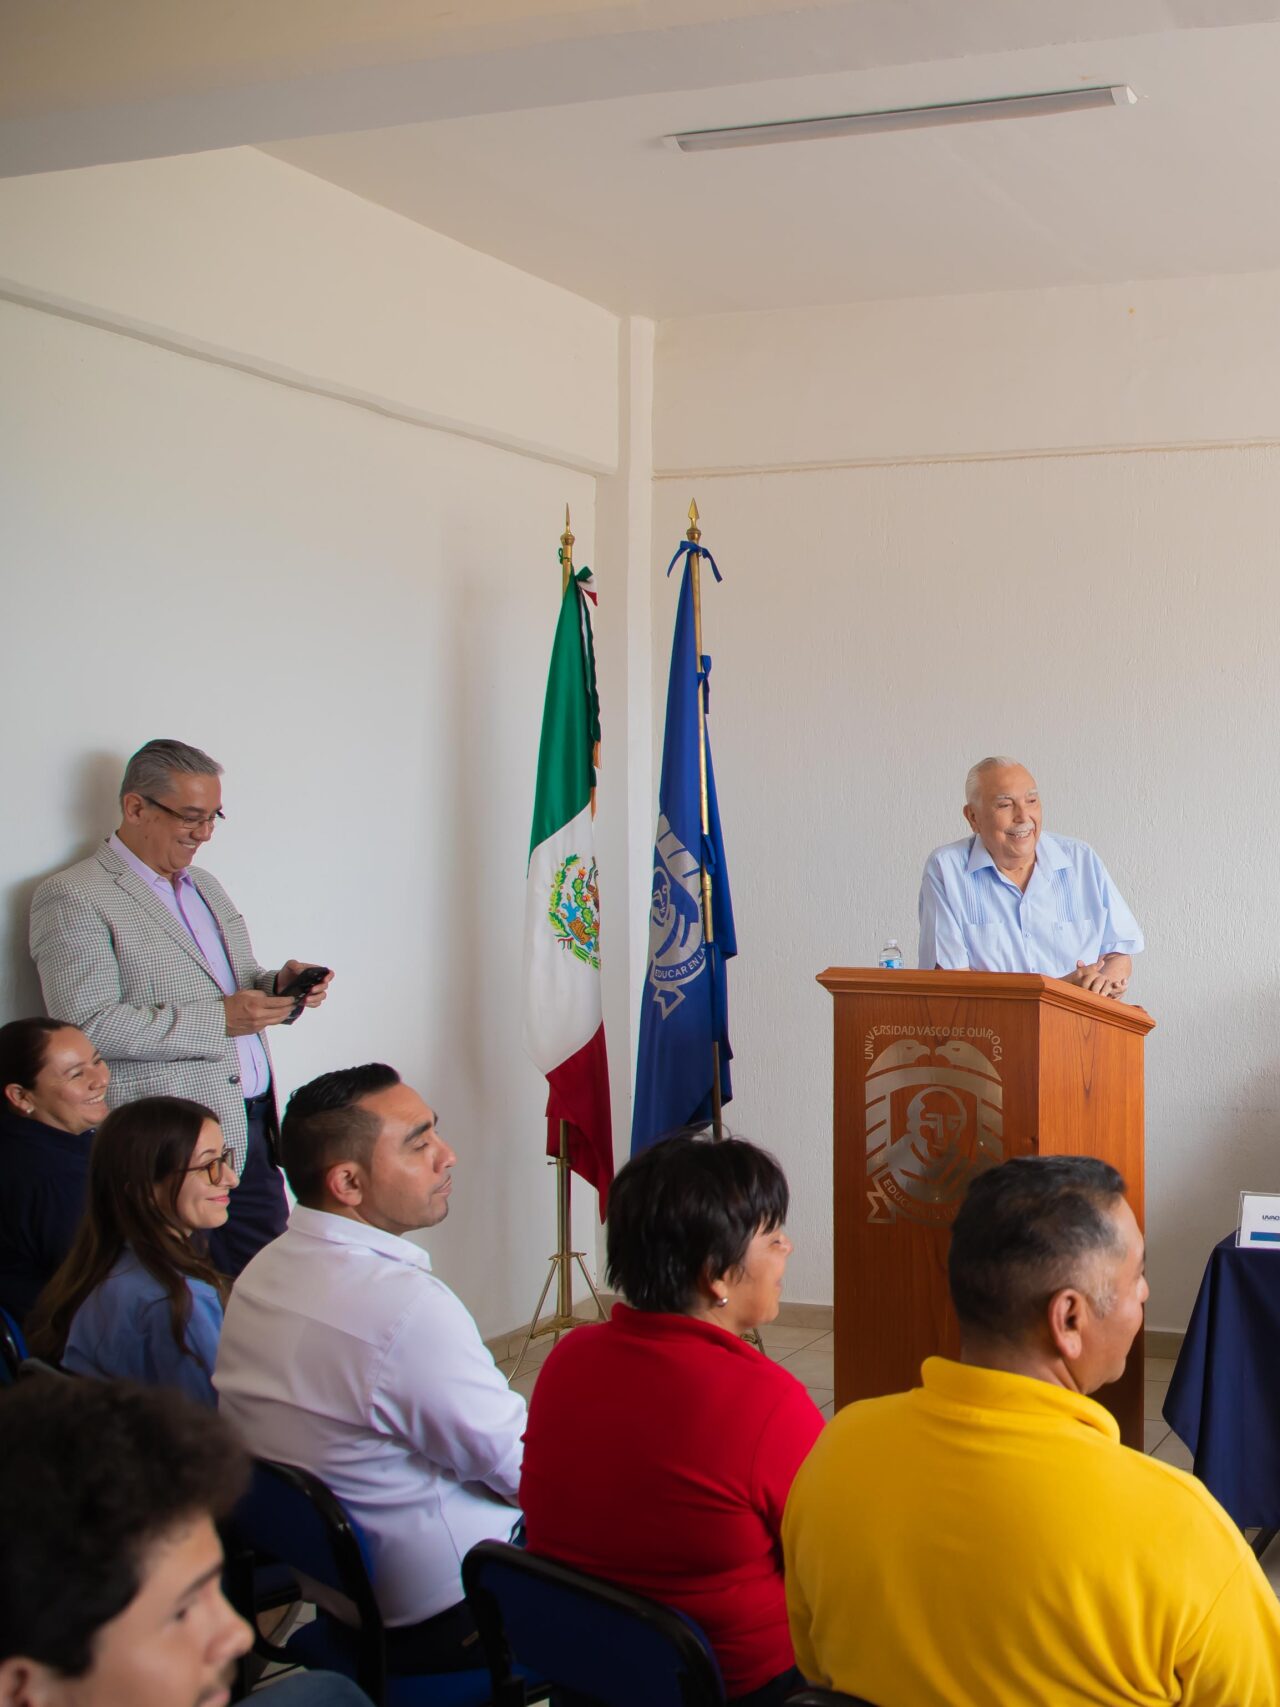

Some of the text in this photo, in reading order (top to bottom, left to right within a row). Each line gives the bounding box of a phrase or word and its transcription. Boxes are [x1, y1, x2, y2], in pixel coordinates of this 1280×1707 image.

[655, 966, 688, 978] EDUCAR
[688, 958, 700, 970] EN
[864, 1025, 1003, 1063] UNIVERSIDAD VASCO DE QUIROGA
